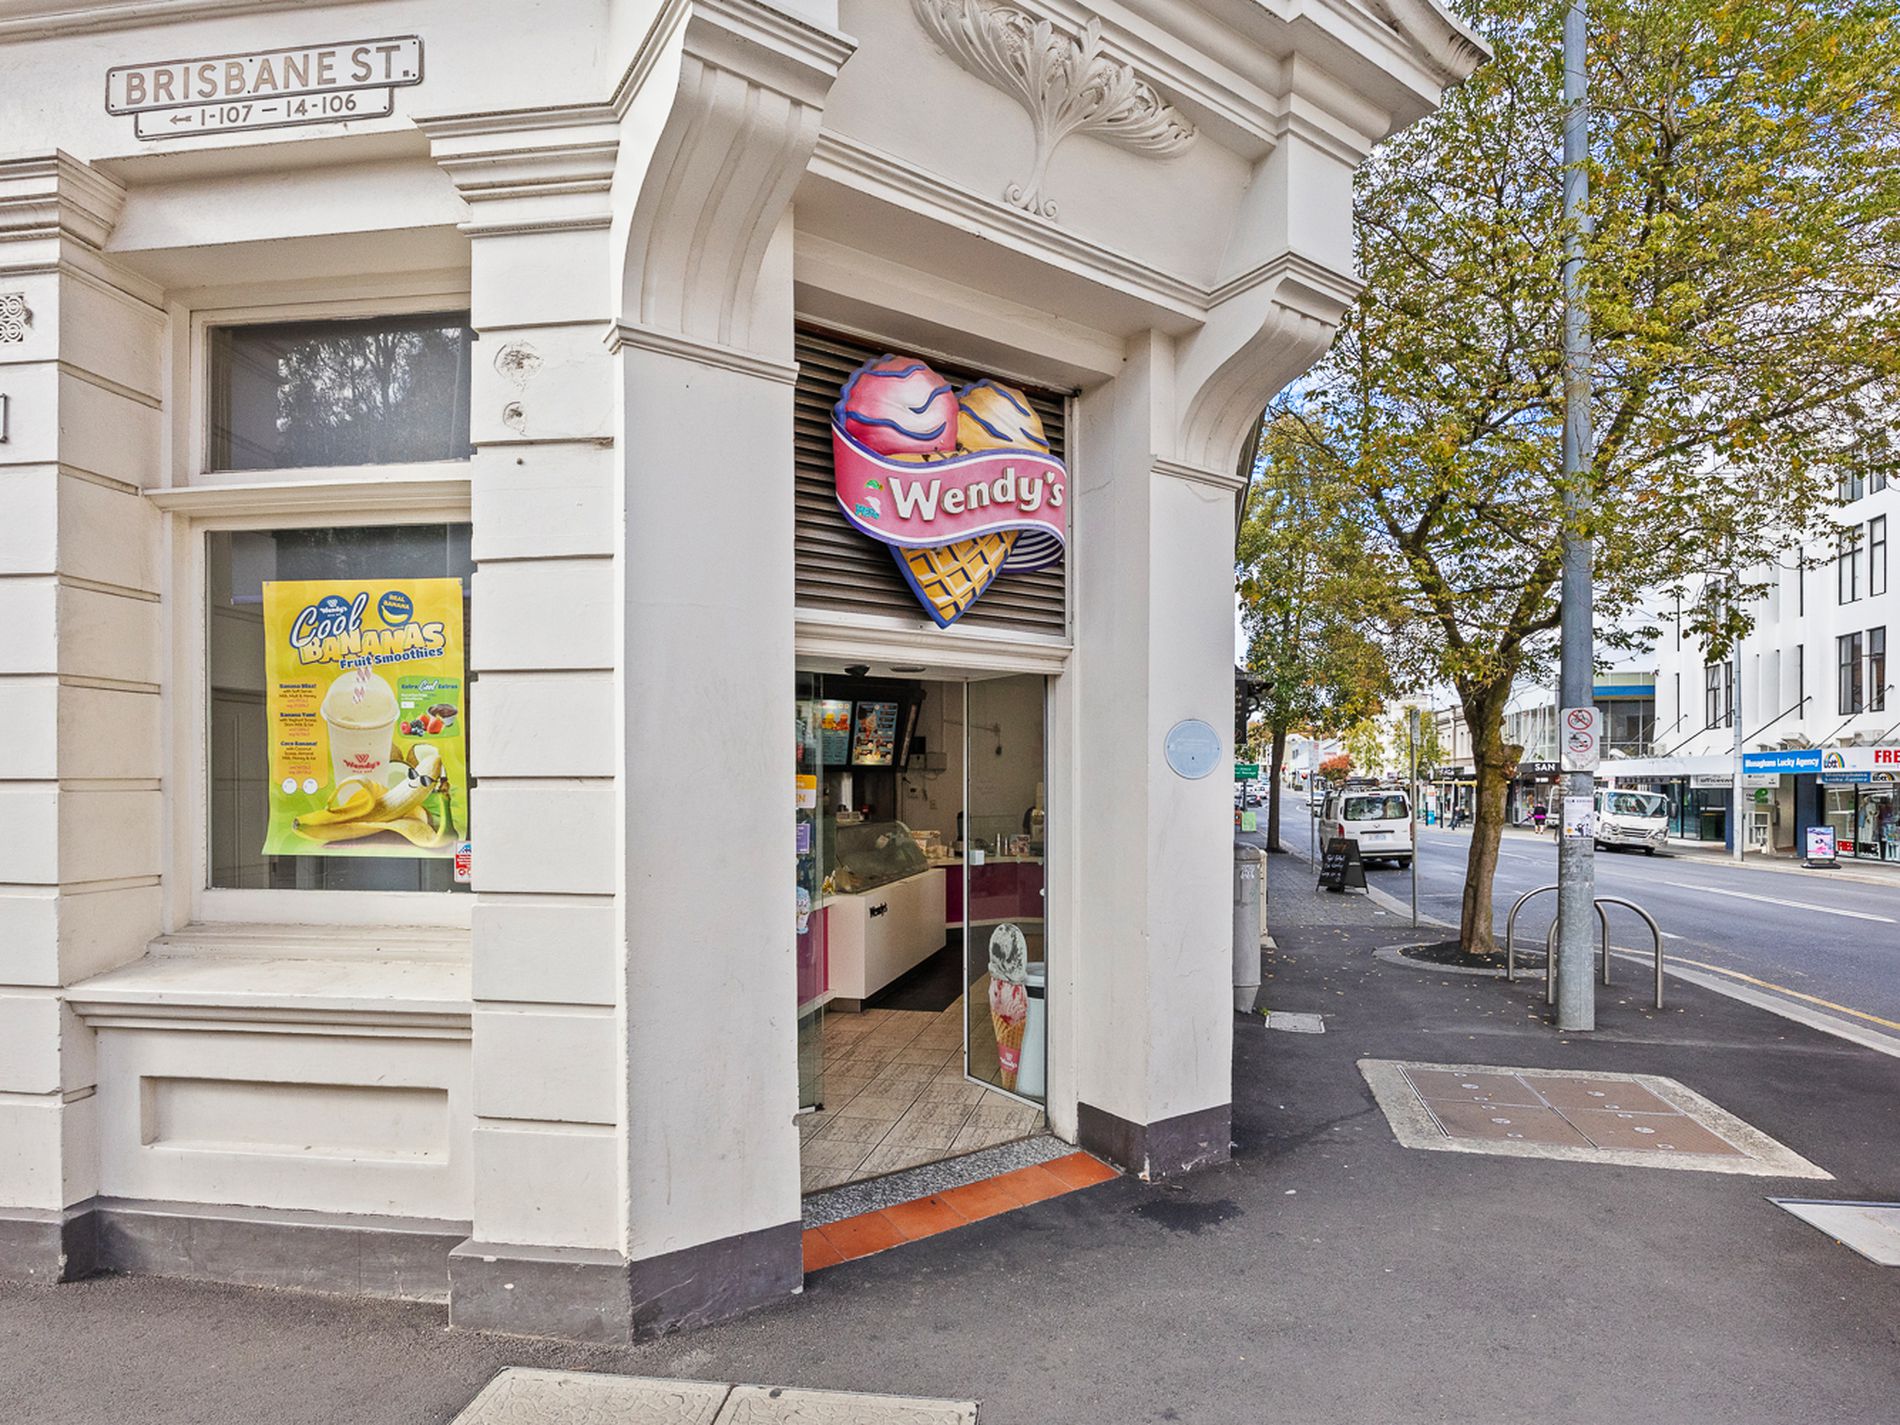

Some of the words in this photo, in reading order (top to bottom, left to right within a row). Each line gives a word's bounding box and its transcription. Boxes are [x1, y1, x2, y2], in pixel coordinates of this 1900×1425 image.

[126, 50, 337, 106] BRISBANE
[351, 45, 401, 82] ST
[200, 104, 253, 126] 1-107
[286, 93, 357, 118] 14-106
[887, 467, 1065, 521] Wendy's
[289, 591, 370, 649] Cool
[382, 600, 410, 610] BANANA
[299, 621, 447, 665] BANANAS
[340, 655, 373, 669] Fruit
[374, 647, 444, 665] Smoothies
[1534, 763, 1556, 772] SAN
[1777, 758, 1795, 769] Lucky
[1796, 757, 1819, 768] Agency
